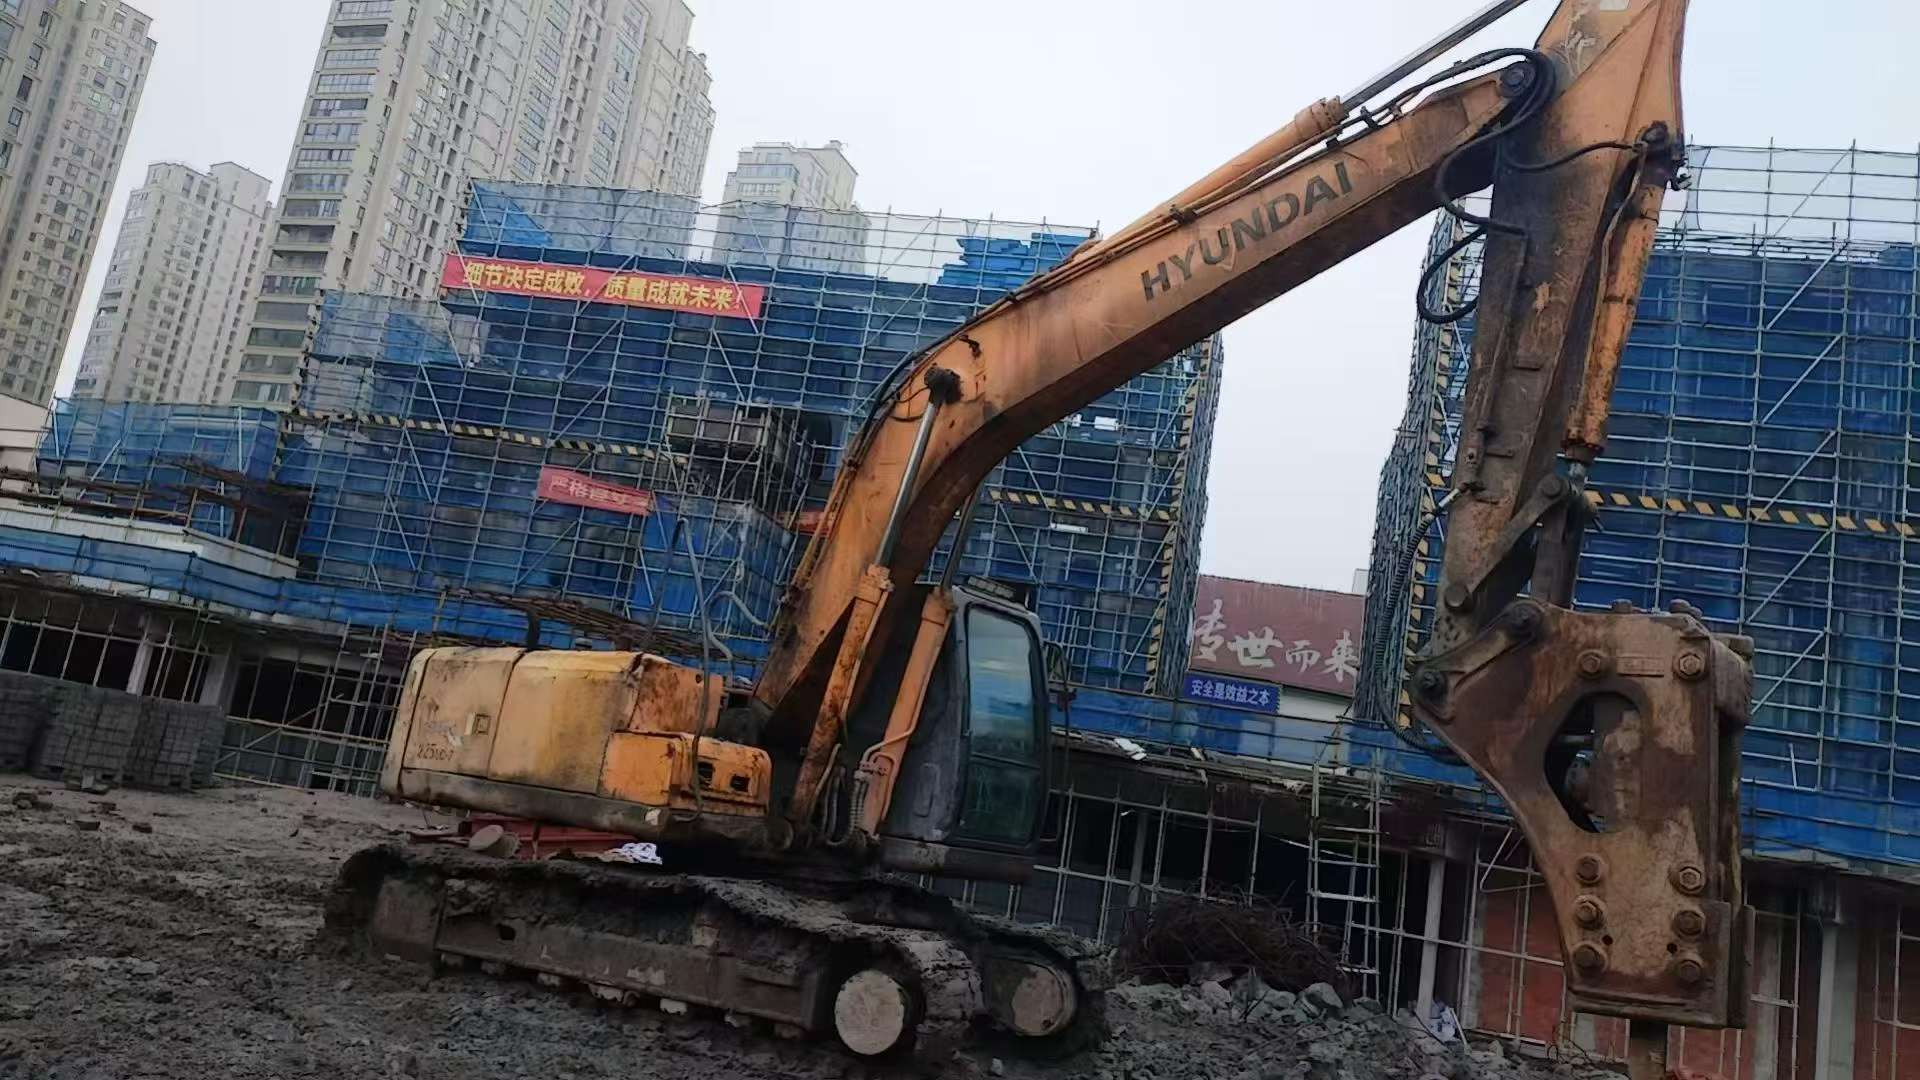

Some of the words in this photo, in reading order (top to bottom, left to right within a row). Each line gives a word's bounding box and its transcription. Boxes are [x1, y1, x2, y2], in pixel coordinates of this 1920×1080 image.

[1141, 160, 1353, 301] HYUNDAI
[1192, 680, 1270, 706] 安全是效益之本
